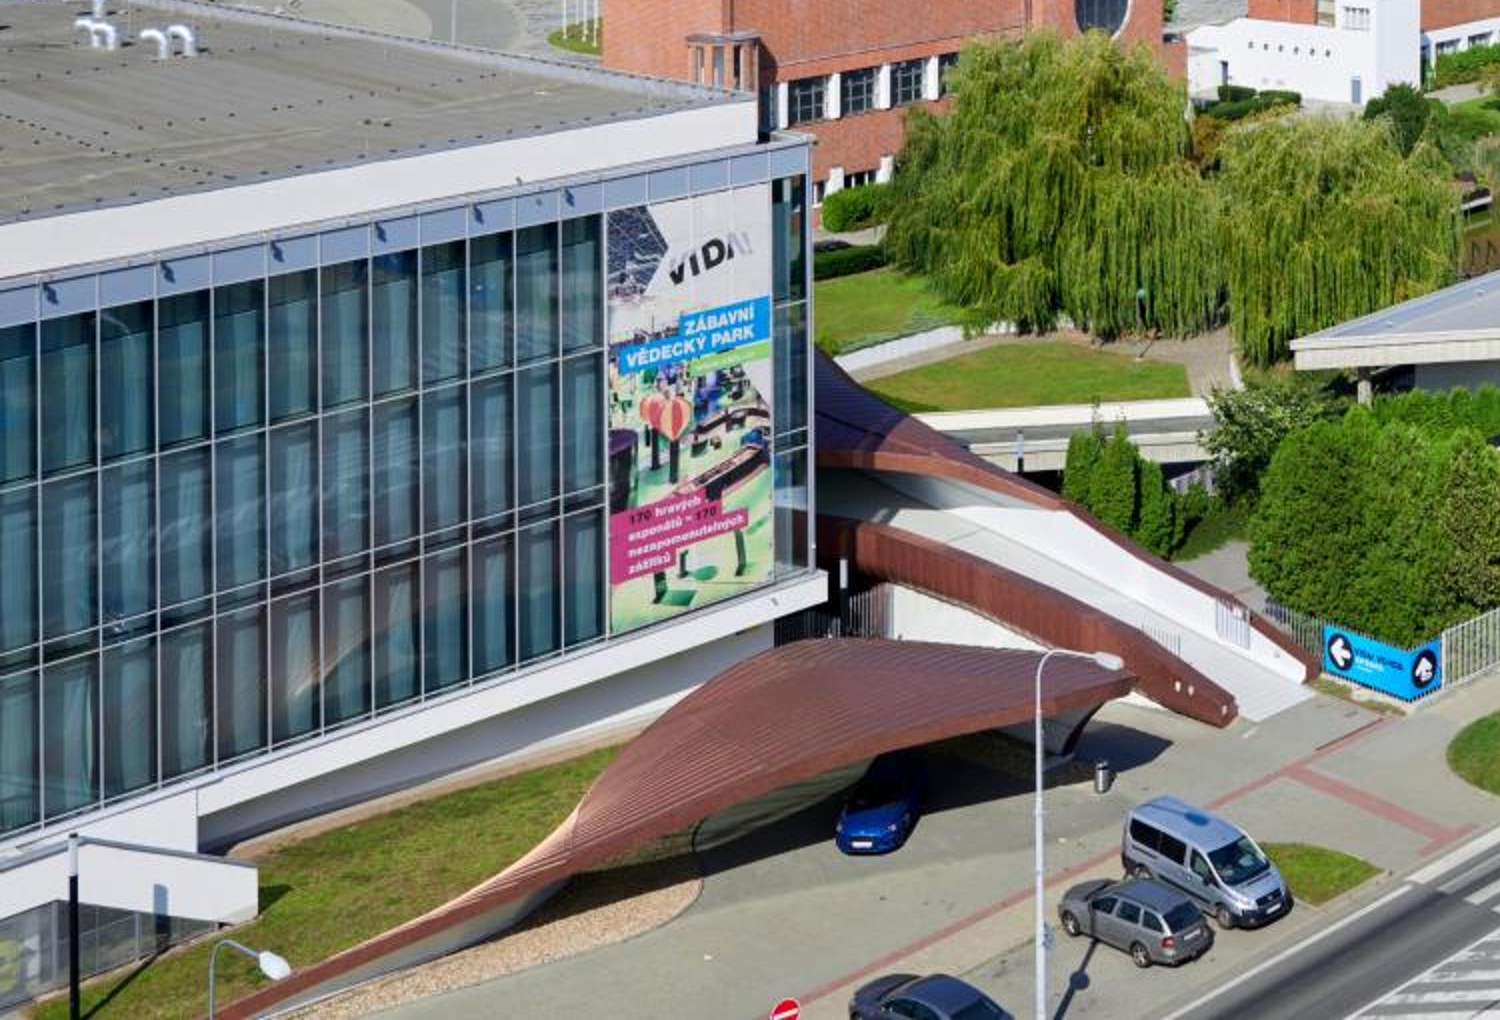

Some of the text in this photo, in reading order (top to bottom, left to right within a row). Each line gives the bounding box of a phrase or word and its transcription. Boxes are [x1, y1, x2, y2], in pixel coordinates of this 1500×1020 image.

[685, 302, 755, 336] ZÁBAVNÍ
[627, 333, 706, 367] VĚDECKÝ
[711, 324, 755, 348] PARK
